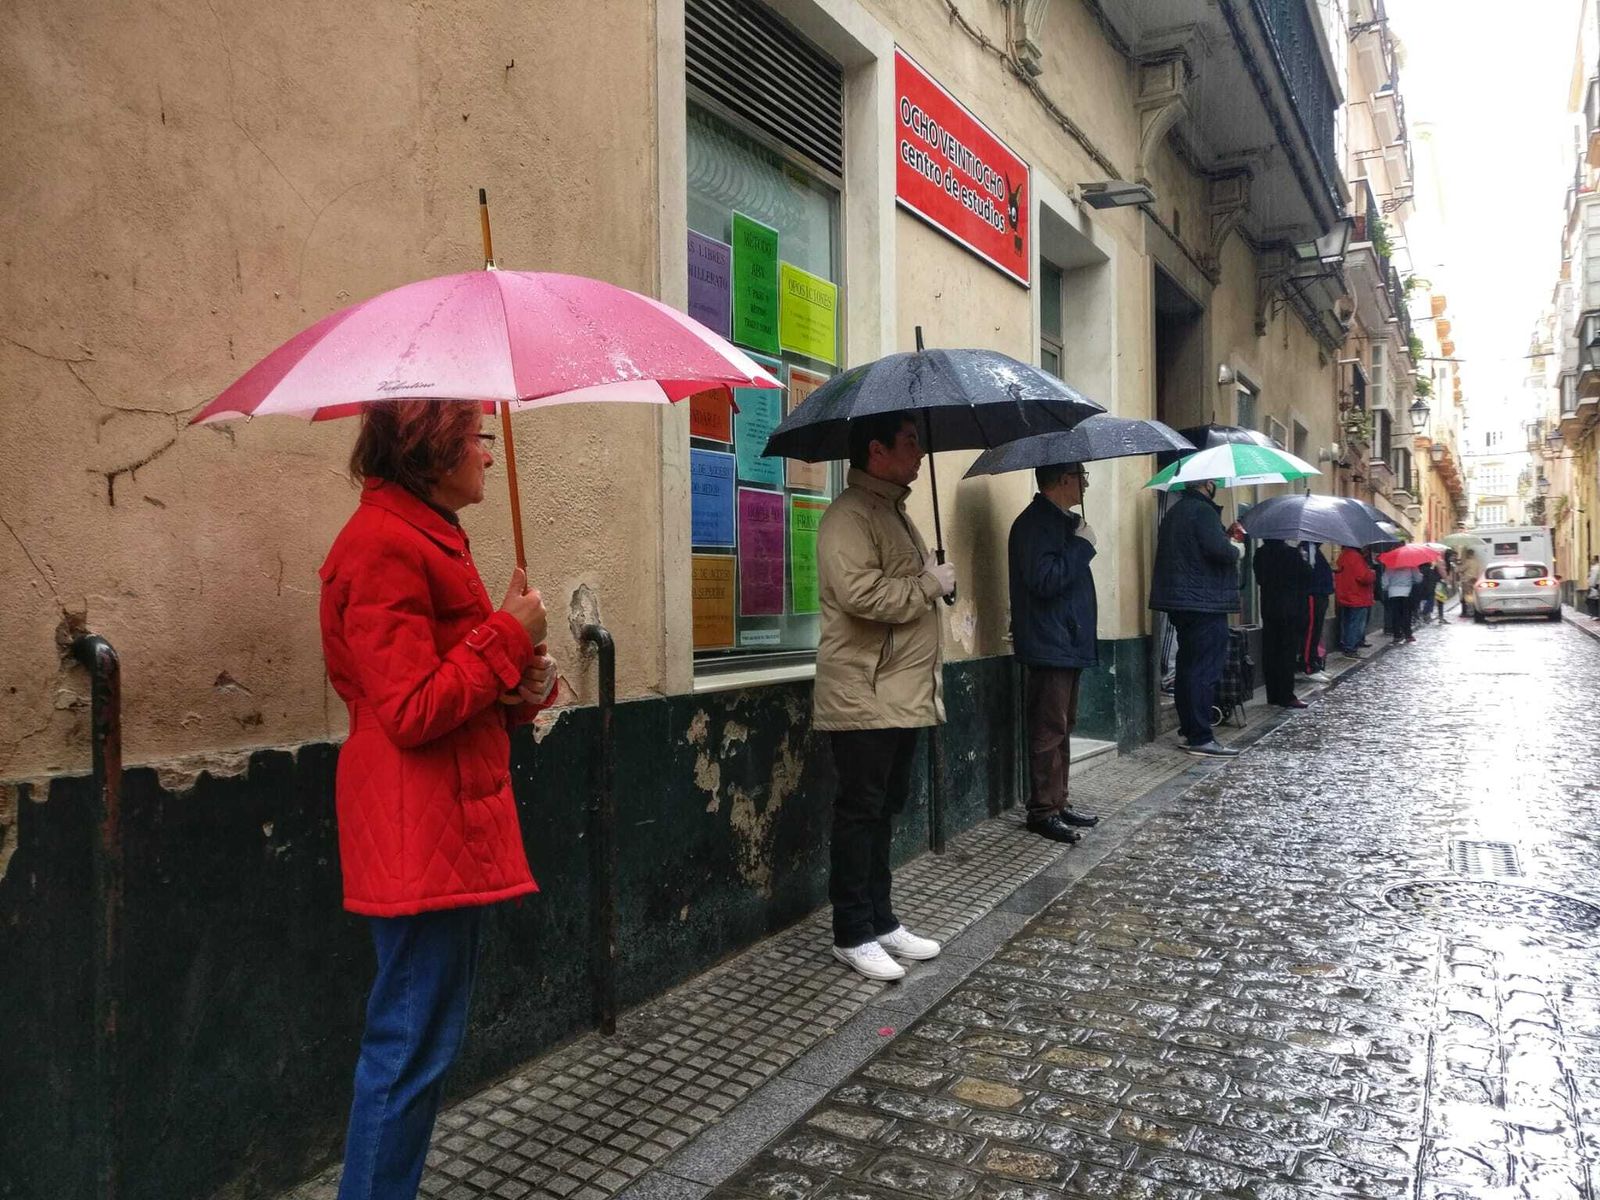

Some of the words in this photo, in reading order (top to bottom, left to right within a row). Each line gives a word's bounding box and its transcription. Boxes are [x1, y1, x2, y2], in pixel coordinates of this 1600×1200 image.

[900, 96, 939, 147] OCHO
[938, 125, 1005, 202] VEINTIOCHO
[900, 139, 942, 187] centro
[944, 168, 960, 200] de
[960, 186, 1006, 234] estudios
[376, 379, 435, 392] Valentino
